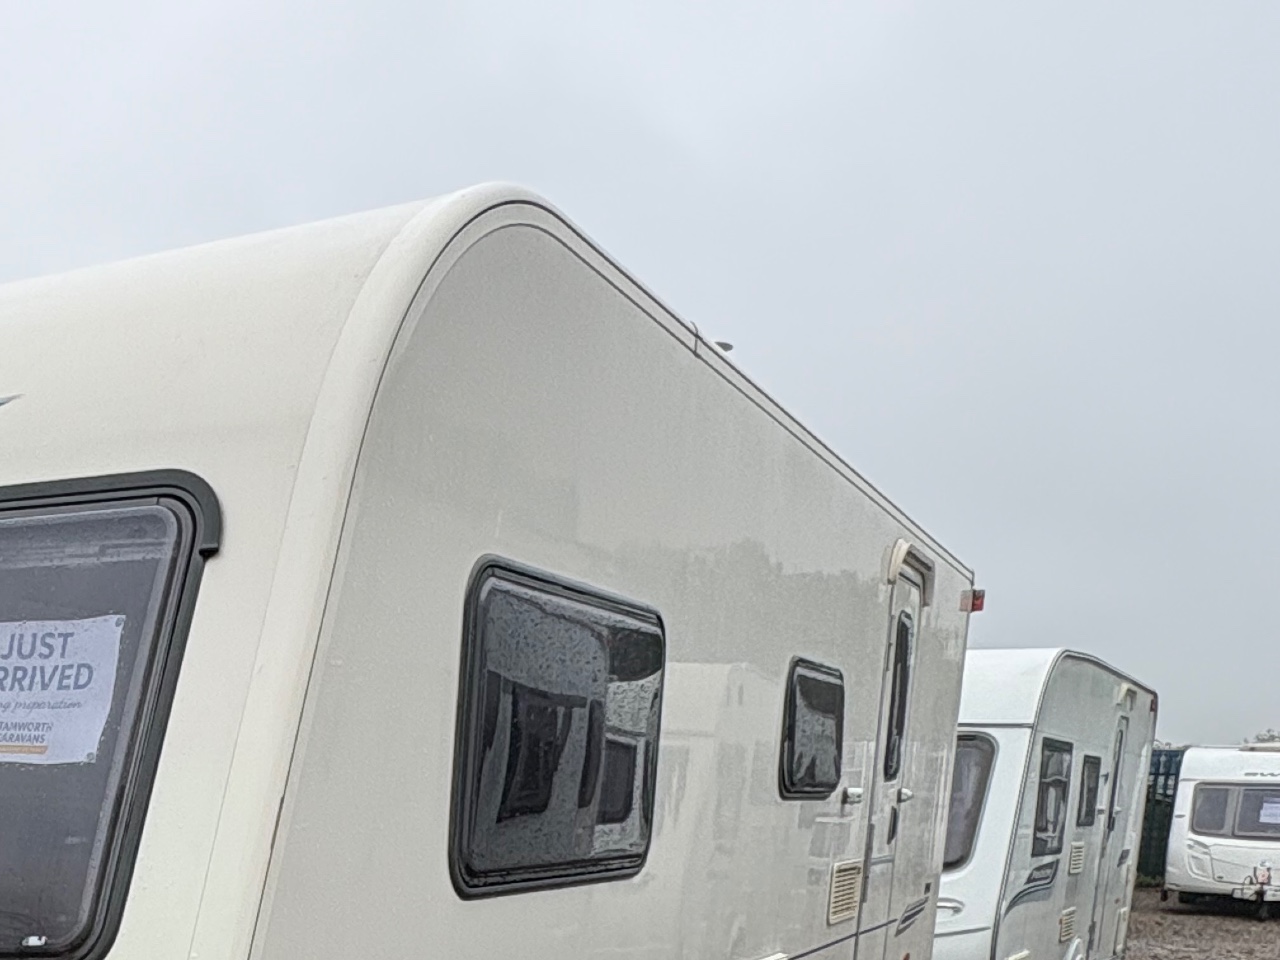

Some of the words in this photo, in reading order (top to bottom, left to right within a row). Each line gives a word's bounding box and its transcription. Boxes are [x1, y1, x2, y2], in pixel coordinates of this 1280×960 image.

[0, 632, 74, 660] JUST
[12, 699, 83, 715] preparation
[0, 721, 53, 732] TAMWORTH
